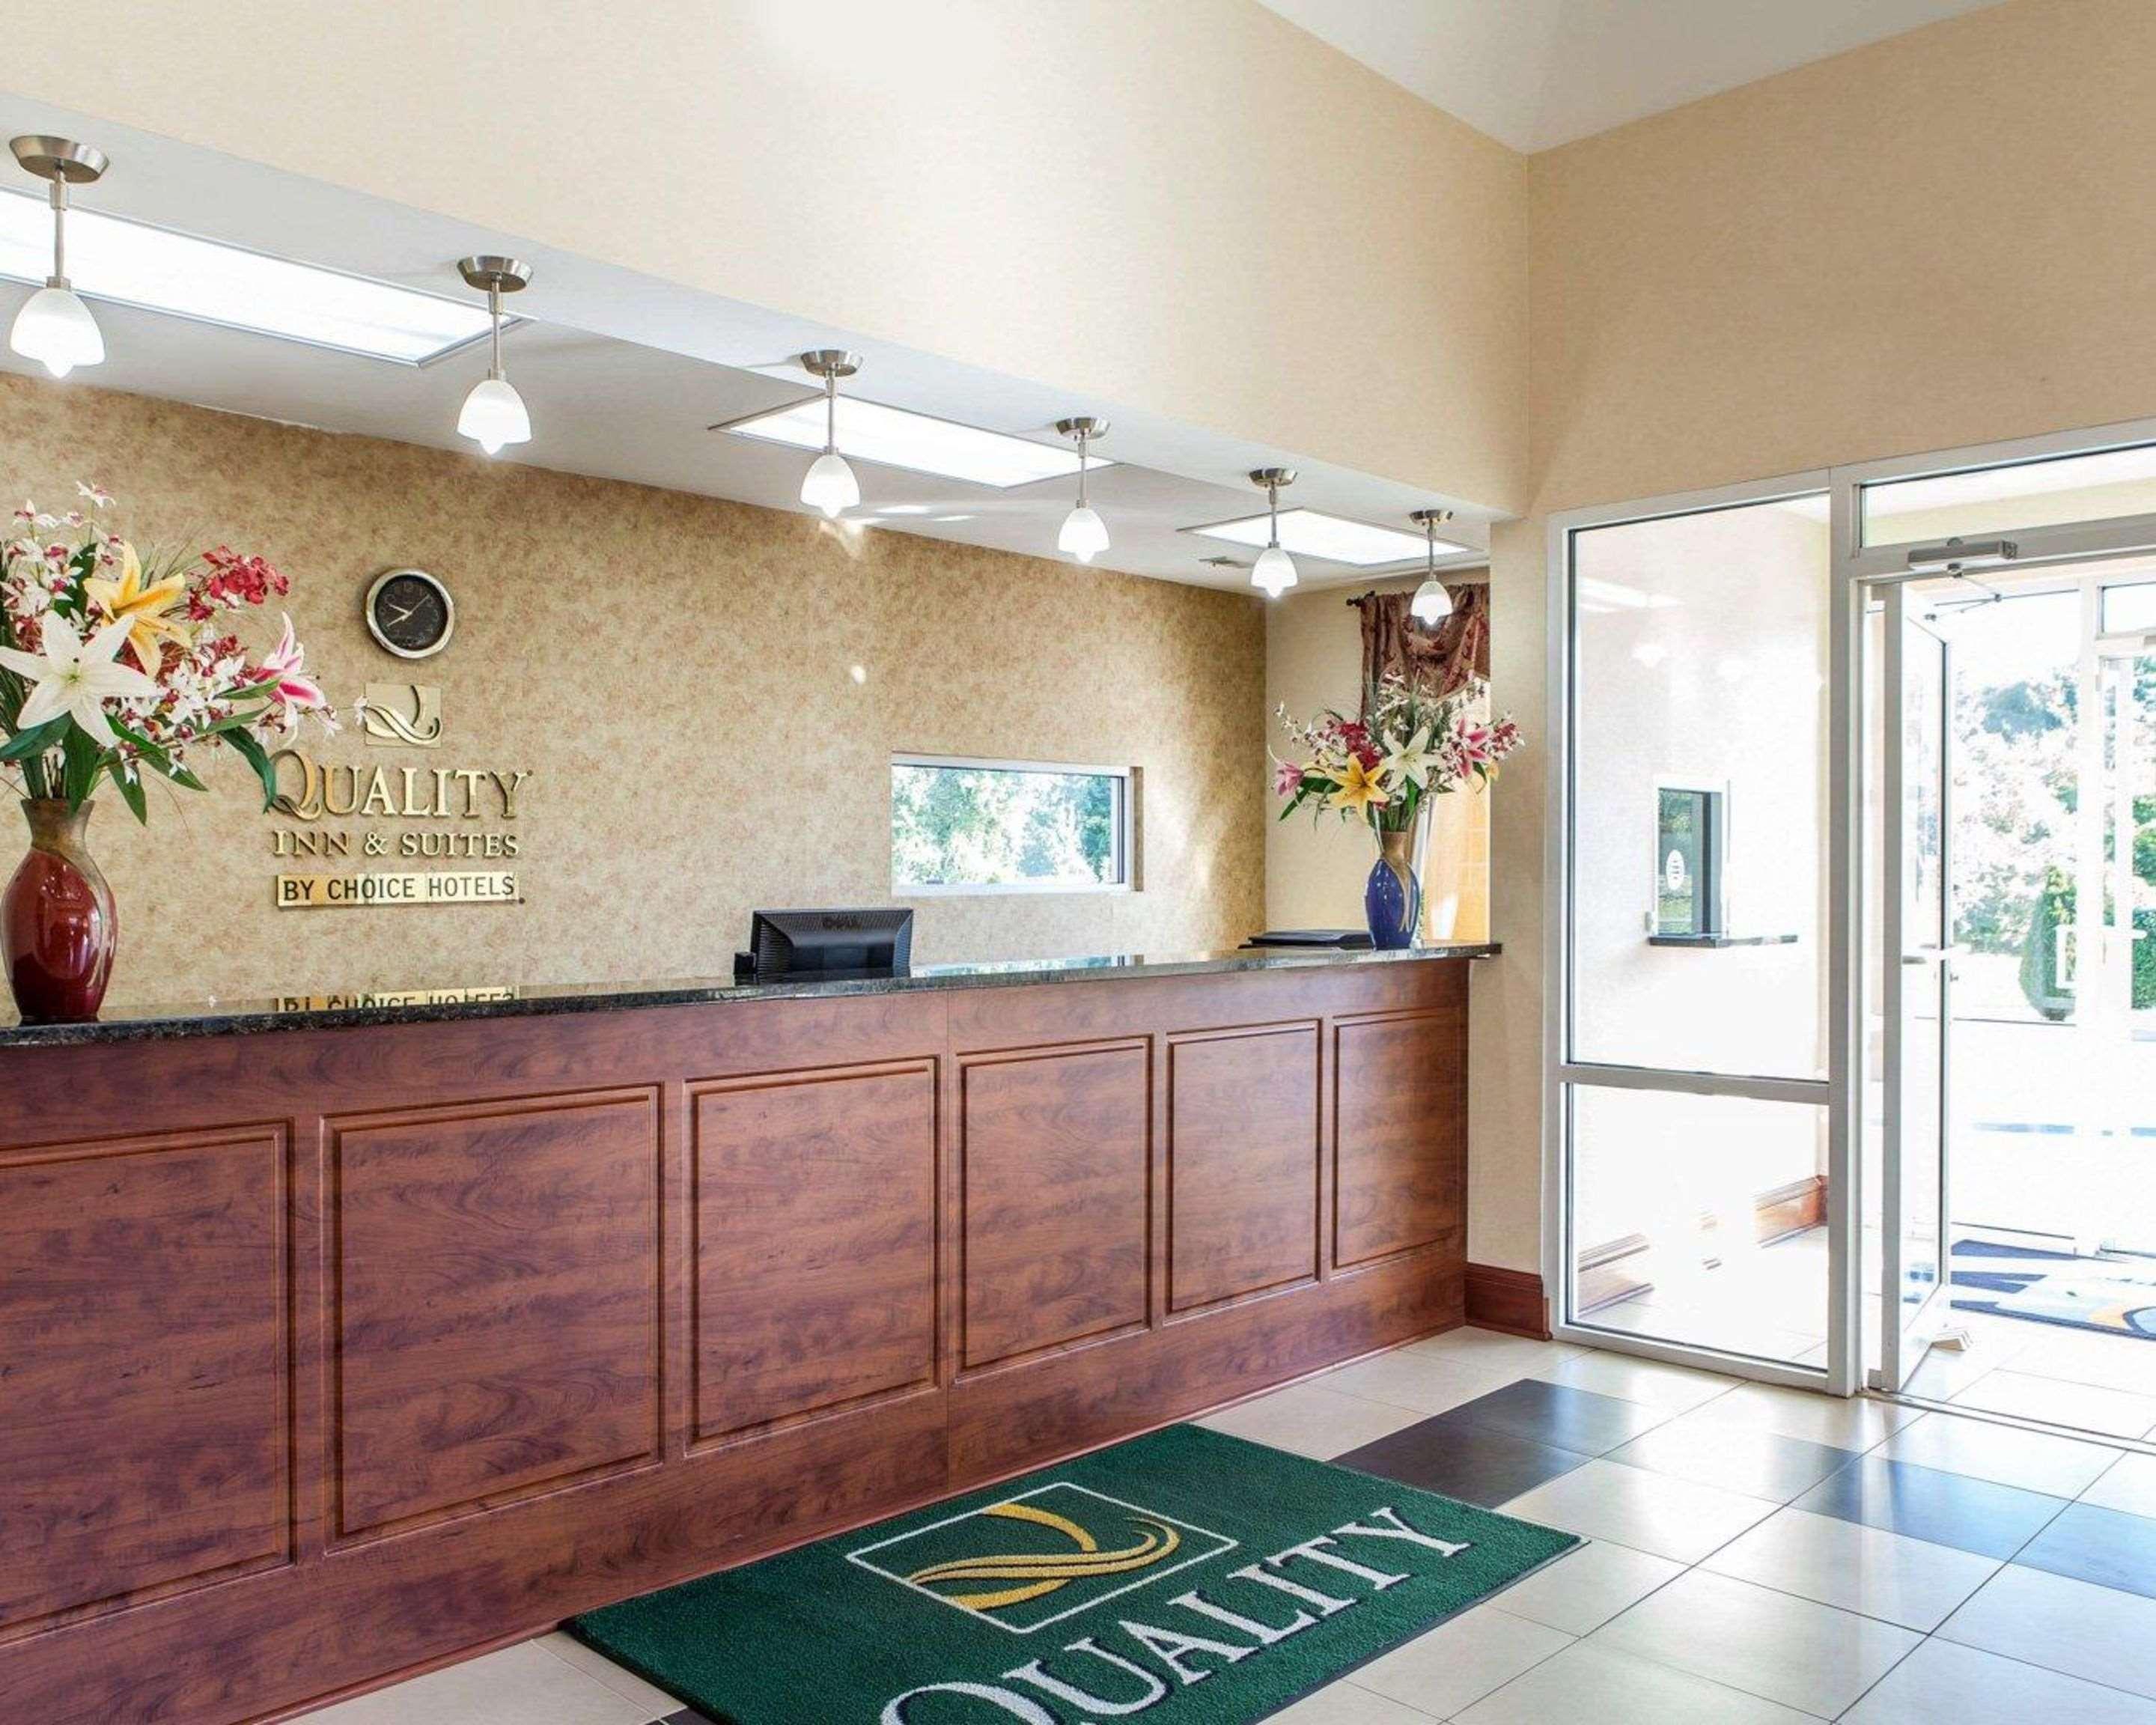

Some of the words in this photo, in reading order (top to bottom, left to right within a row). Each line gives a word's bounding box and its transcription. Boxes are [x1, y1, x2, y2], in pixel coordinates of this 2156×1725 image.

[270, 749, 526, 820] QUALITY
[272, 830, 350, 856] INN
[365, 832, 389, 856] &
[400, 833, 520, 857] SUITES
[284, 880, 314, 900] BY
[328, 878, 416, 900] CHOICE
[428, 876, 515, 898] HOTELS
